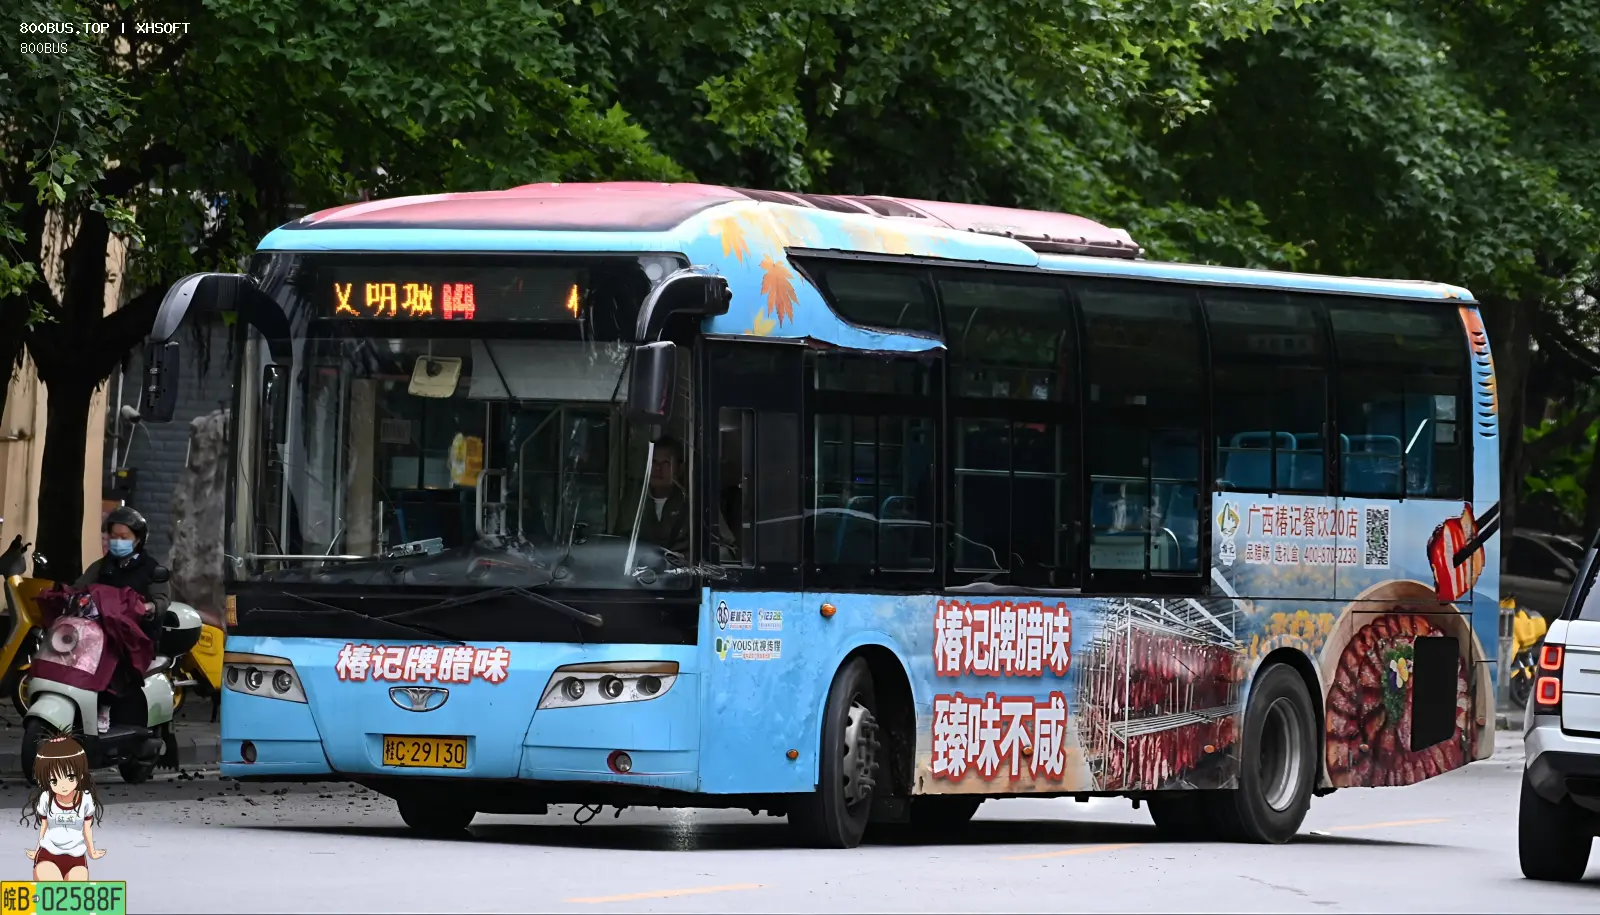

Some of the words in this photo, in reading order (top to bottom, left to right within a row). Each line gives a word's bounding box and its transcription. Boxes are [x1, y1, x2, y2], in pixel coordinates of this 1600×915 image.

[1246, 503, 1359, 539] 广西椿记餐饮20店
[1245, 543, 1271, 562] 品腊味
[1275, 544, 1299, 563] 选礼盒
[934, 603, 1072, 675] 椿记牌腊味
[335, 643, 510, 684] 椿记牌腊味
[385, 739, 465, 764] 桂C·29130
[932, 694, 1067, 779] 臻味不咸
